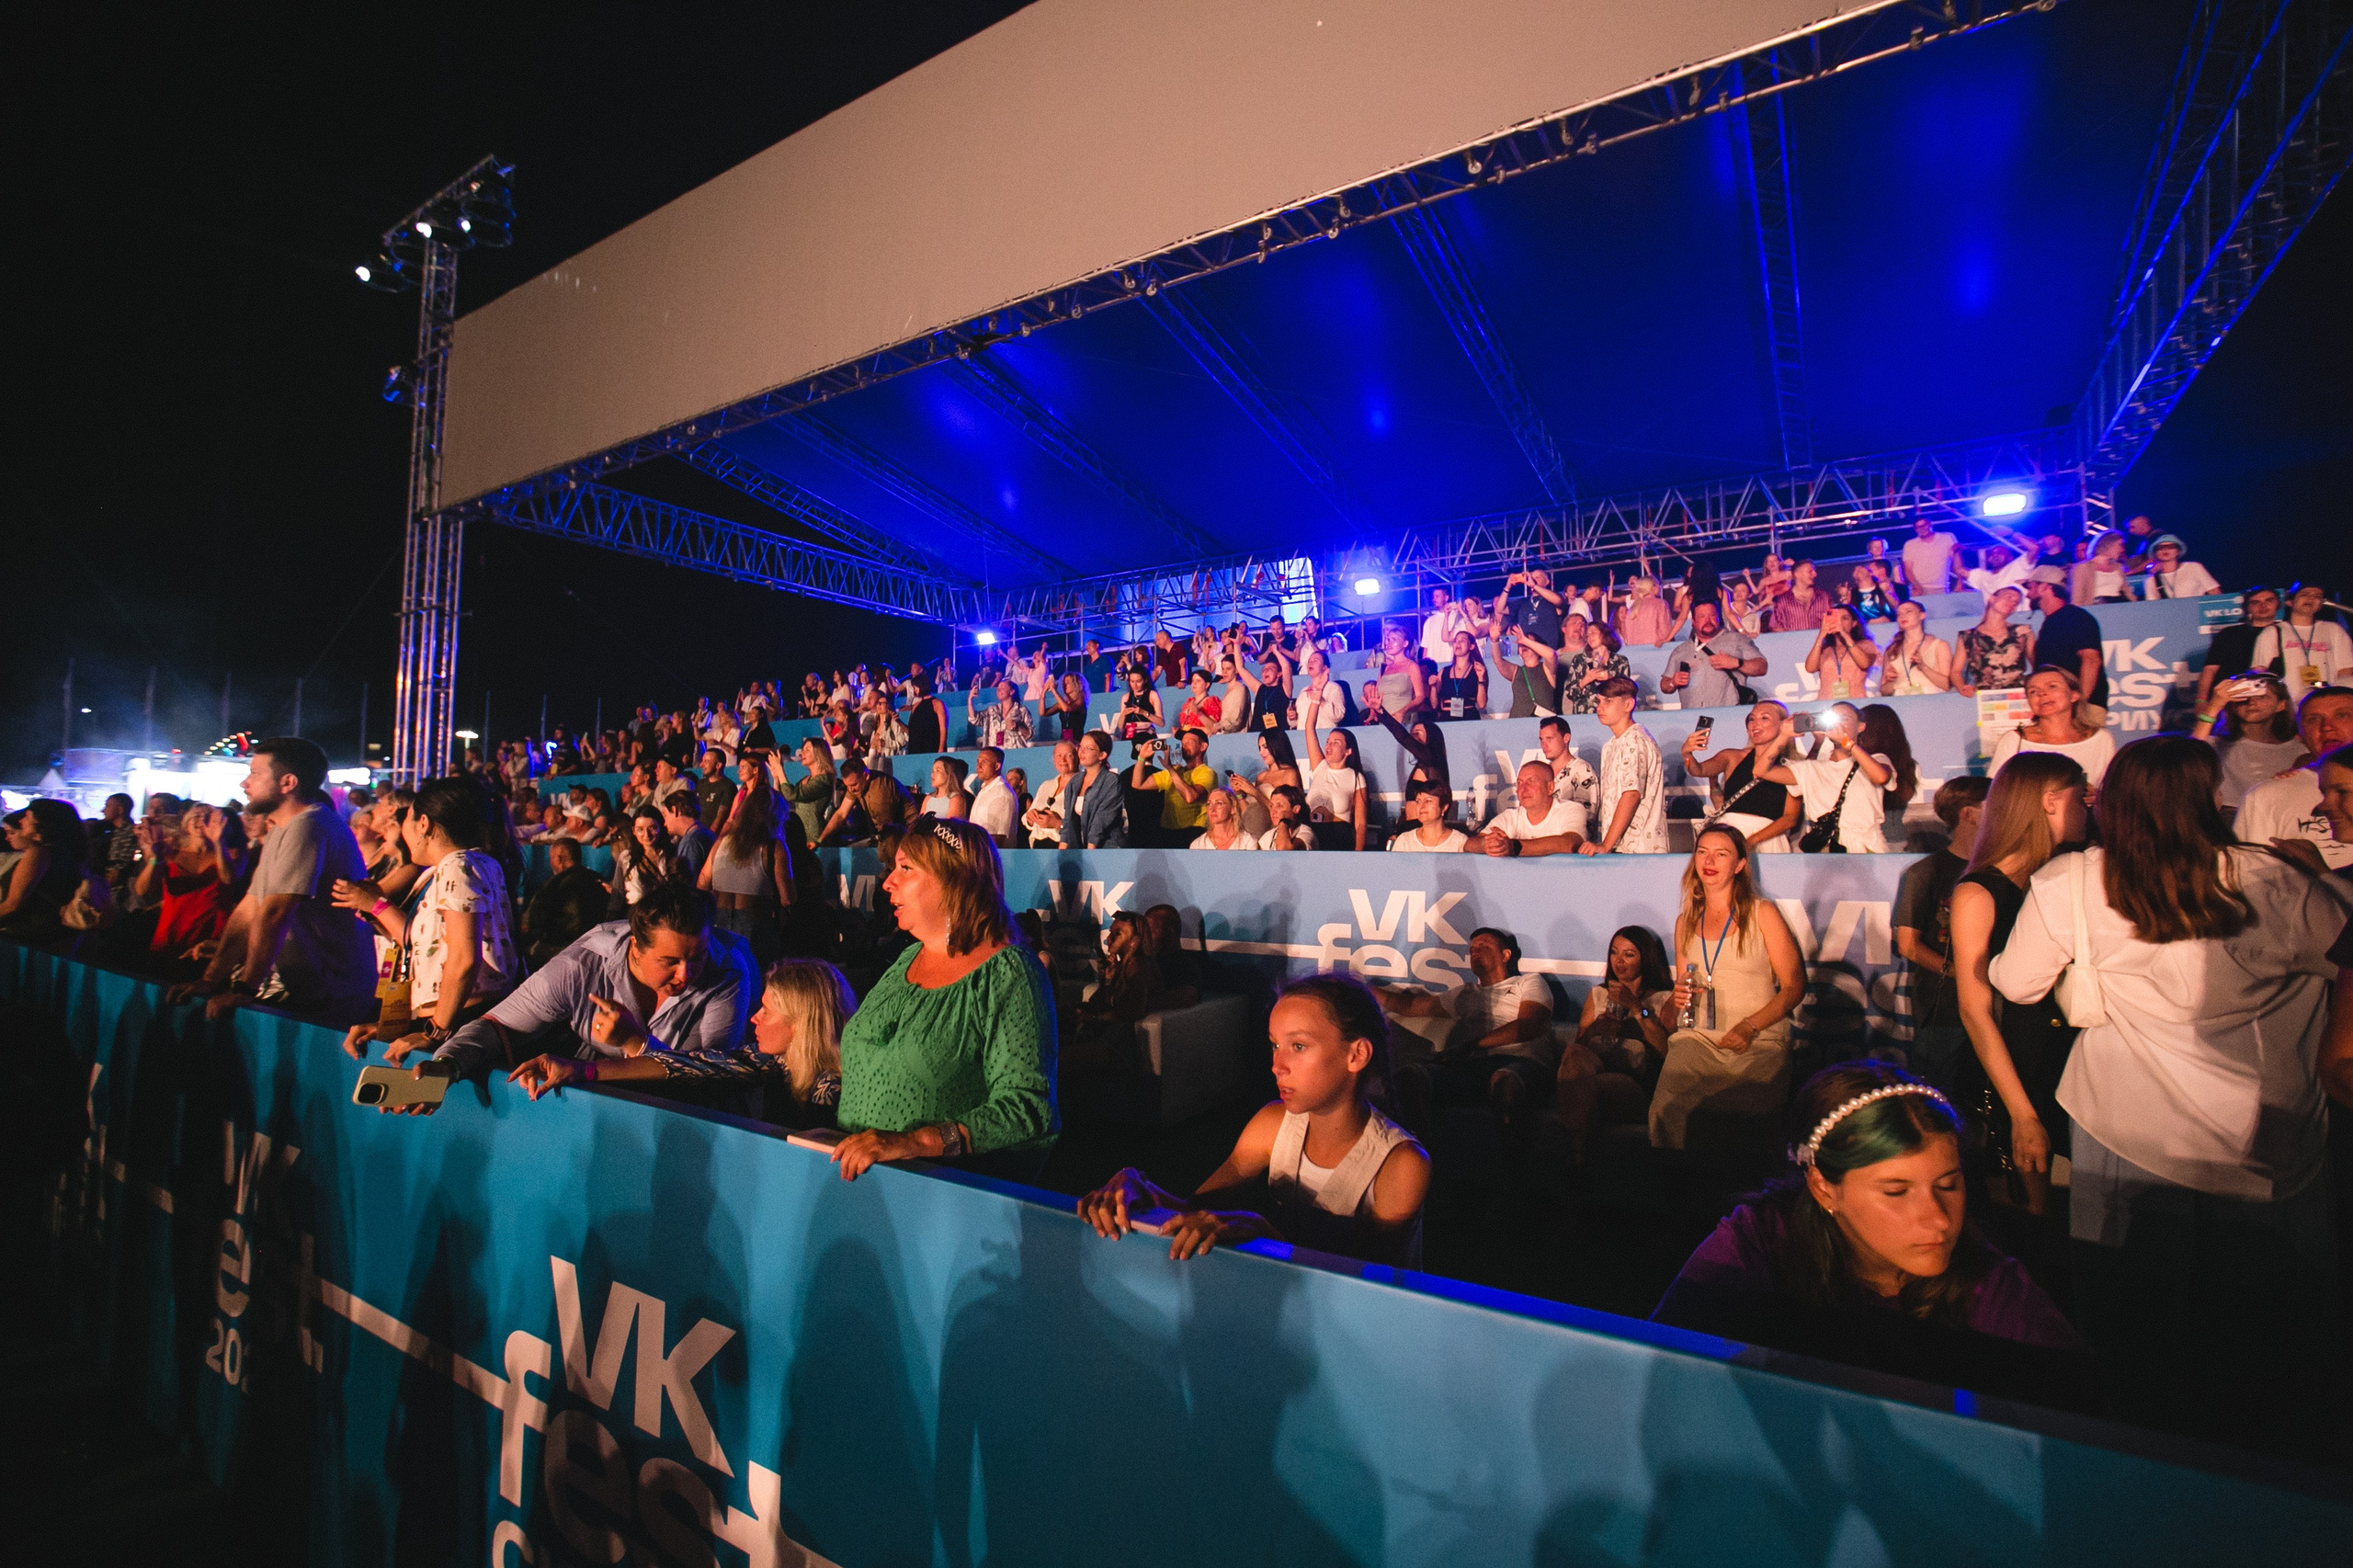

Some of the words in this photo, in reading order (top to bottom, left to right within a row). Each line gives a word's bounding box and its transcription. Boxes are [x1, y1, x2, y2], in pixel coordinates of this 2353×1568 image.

[1048, 880, 1135, 925] VK
[1348, 889, 1468, 945] VK
[1317, 923, 1476, 995] fes
[550, 1255, 736, 1478] VK
[499, 1329, 782, 1568] fest
